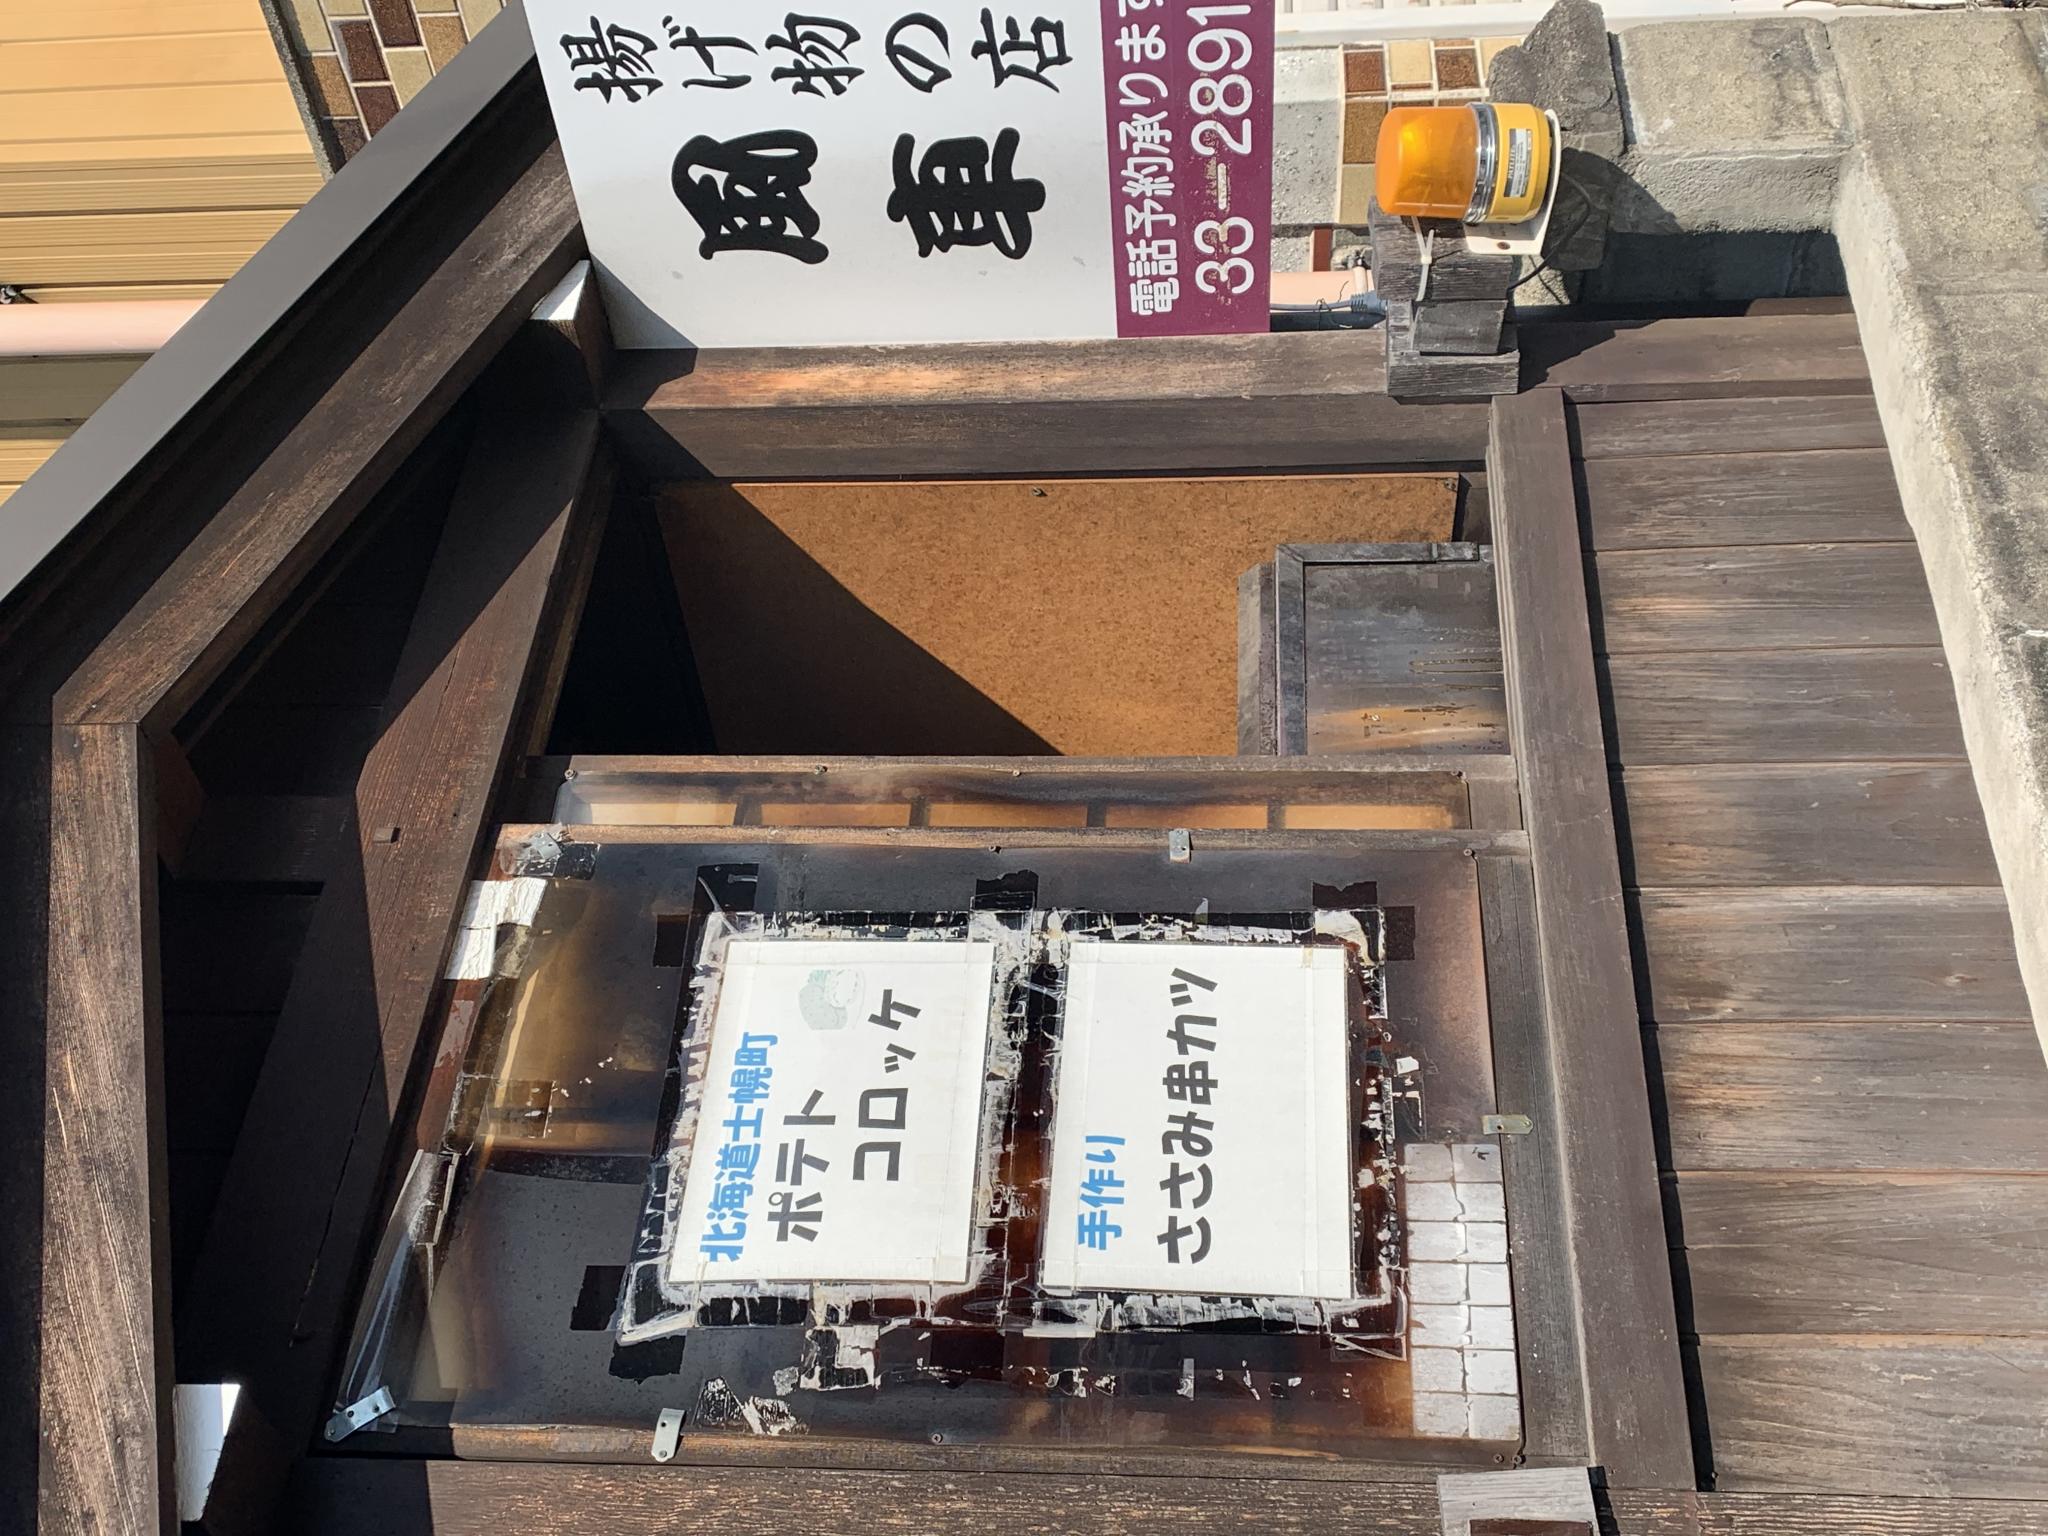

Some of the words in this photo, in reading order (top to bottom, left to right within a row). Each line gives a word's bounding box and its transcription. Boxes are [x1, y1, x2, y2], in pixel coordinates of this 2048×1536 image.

[560, 8, 1072, 103] 揚げ物の店
[672, 128, 1046, 264] 風車
[701, 1033, 777, 1262] 北海道士幌町
[853, 990, 920, 1180] コロッケ
[1157, 967, 1218, 1263] ささみ串カツ
[768, 1089, 836, 1242] ポテト
[1077, 1135, 1126, 1250] 手作り
